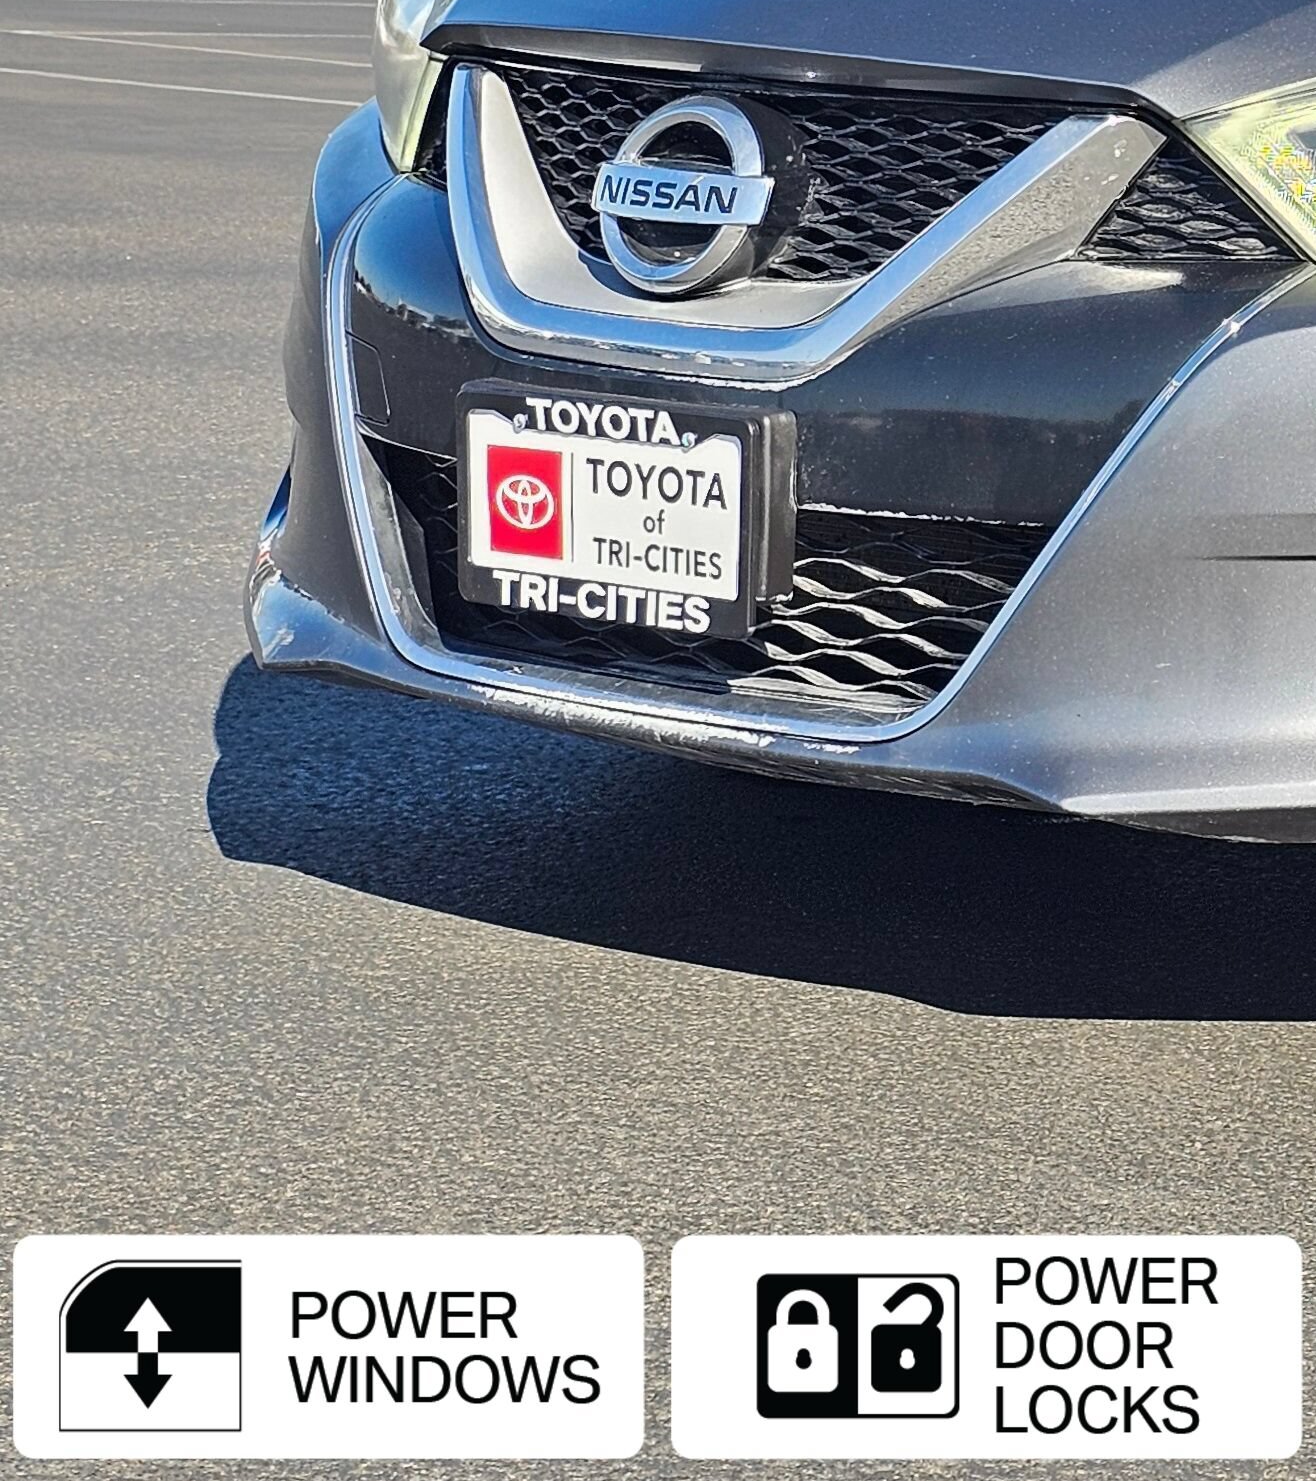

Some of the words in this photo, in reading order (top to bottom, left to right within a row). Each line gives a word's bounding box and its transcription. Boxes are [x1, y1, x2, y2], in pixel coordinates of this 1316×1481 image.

[599, 174, 738, 214] NISSAN
[526, 396, 682, 446] TOYOTA
[586, 457, 728, 510] TOYOTA
[643, 509, 666, 535] of
[592, 536, 722, 580] TRI-CITIES
[492, 569, 711, 633] TRI-CITIES
